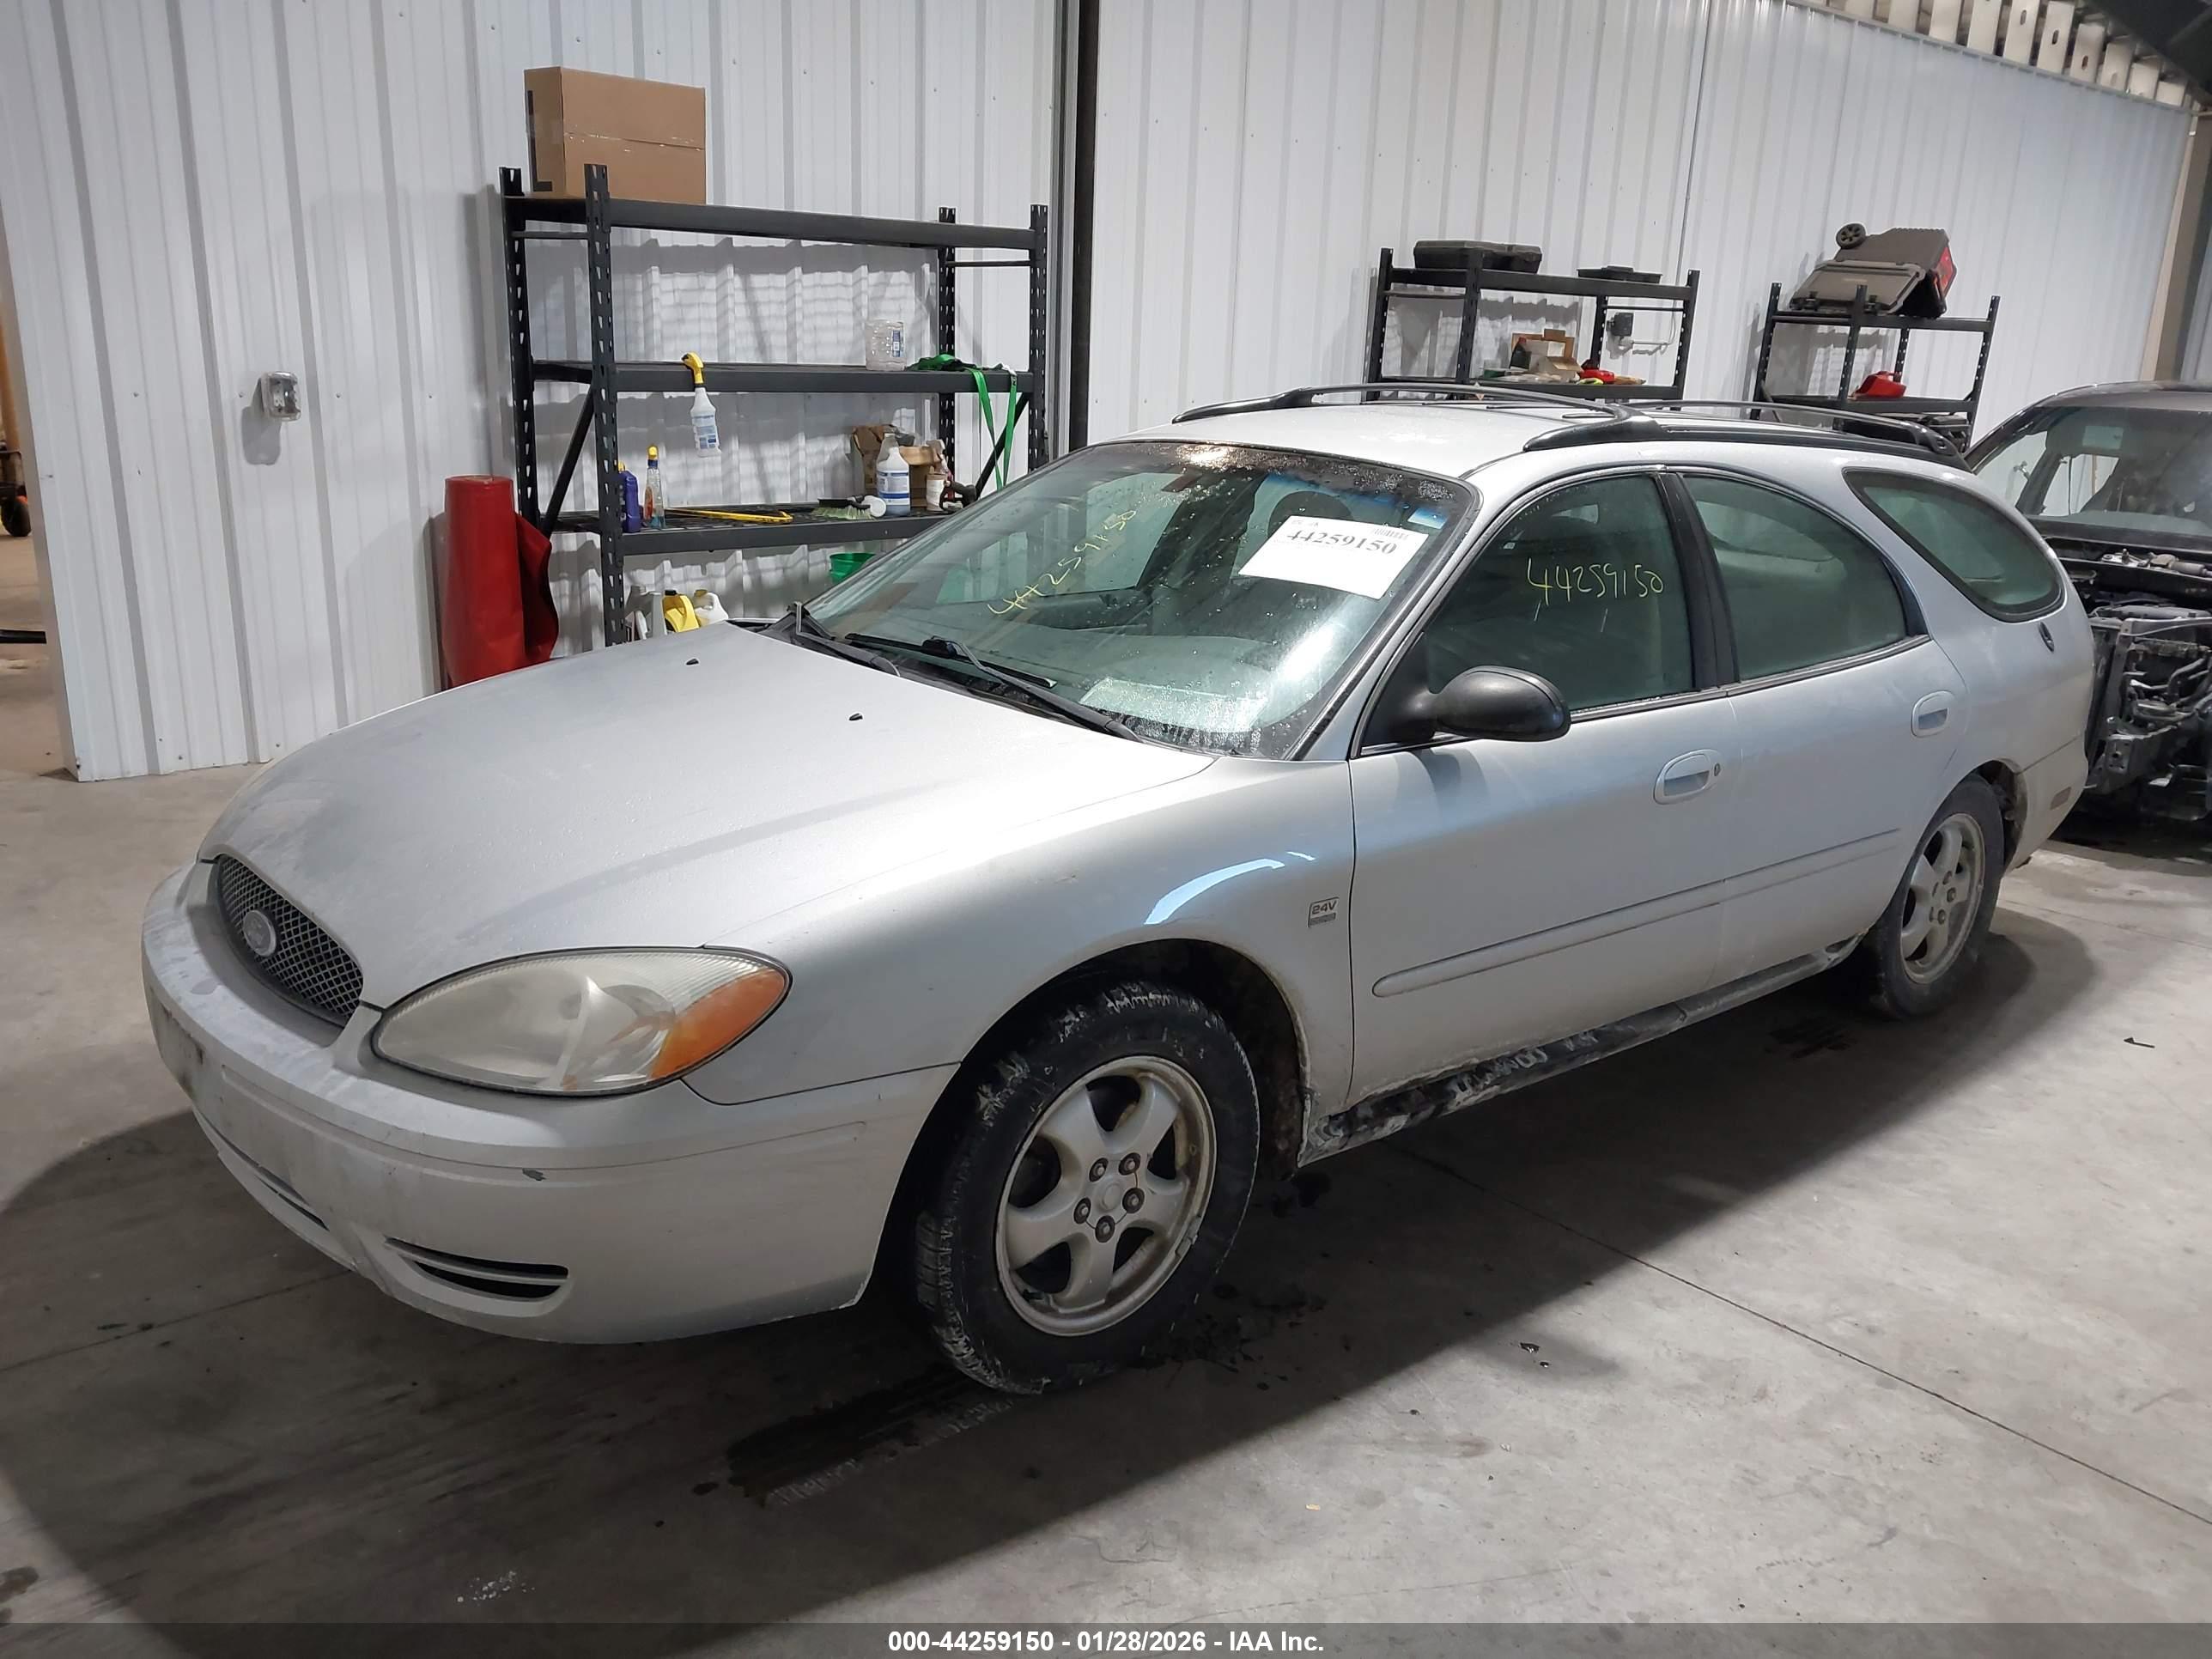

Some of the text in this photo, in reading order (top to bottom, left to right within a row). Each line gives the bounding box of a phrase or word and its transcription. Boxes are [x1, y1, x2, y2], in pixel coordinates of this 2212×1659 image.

[1287, 529, 1398, 555] 44259150
[1527, 557, 1664, 606] 44259150
[1311, 900, 1338, 915] 24V
